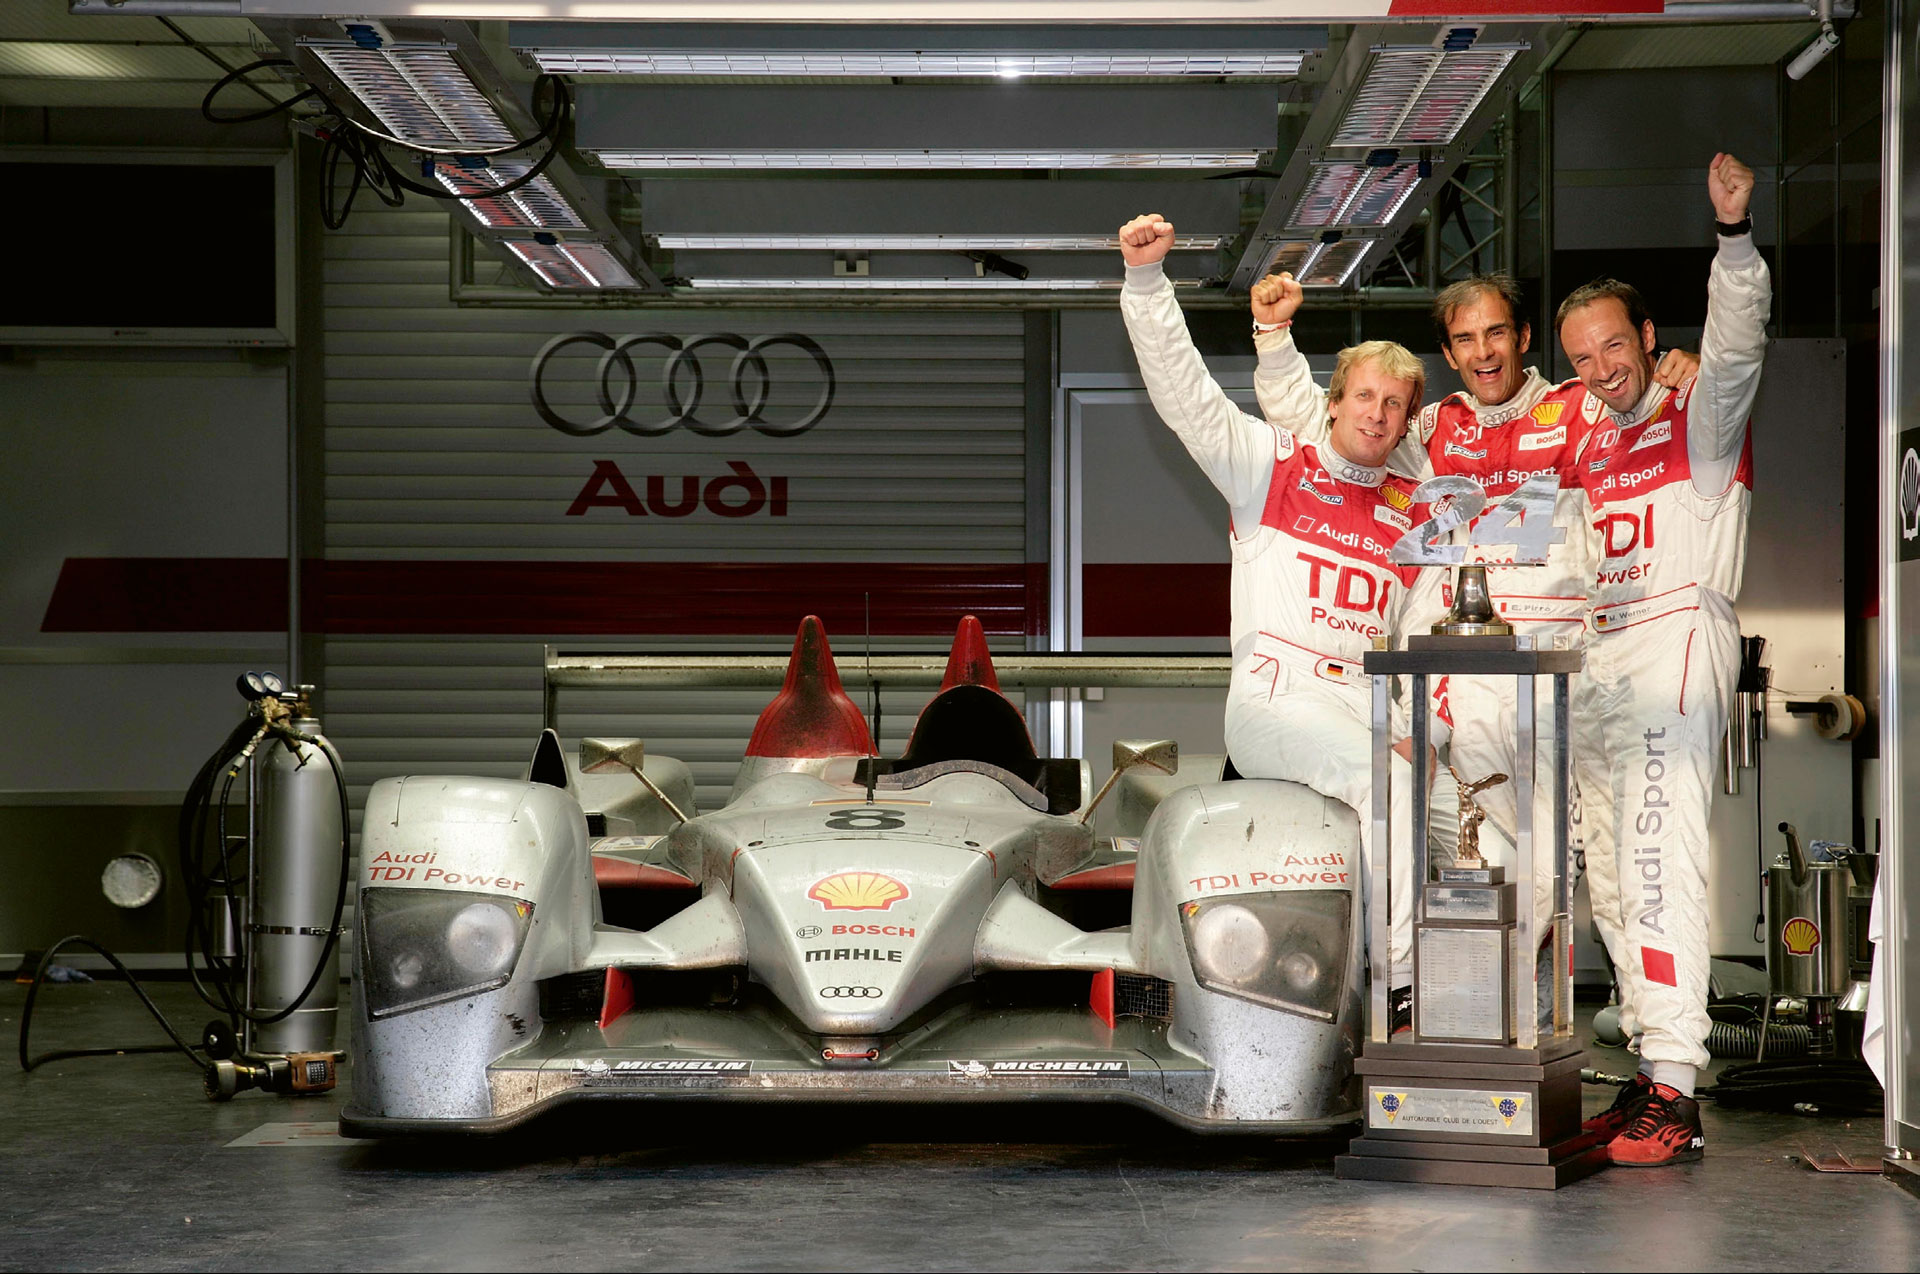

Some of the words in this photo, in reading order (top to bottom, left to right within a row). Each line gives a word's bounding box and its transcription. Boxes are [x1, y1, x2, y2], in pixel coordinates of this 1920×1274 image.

[1536, 430, 1564, 444] BOSCH
[1594, 429, 1621, 450] TDI
[1641, 426, 1670, 442] BOSCH
[1619, 461, 1665, 487] Sport
[565, 460, 788, 518] Audi
[1390, 514, 1411, 530] BOSC
[1316, 522, 1359, 547] Audi
[1296, 551, 1393, 621] TDI
[1636, 727, 1670, 836] Sport
[825, 808, 906, 831] 8
[373, 851, 438, 865] Audi
[1284, 853, 1345, 867] Audi
[368, 866, 416, 882] TDI
[423, 868, 526, 892] Power
[1189, 874, 1240, 893] TDI
[1250, 872, 1349, 887] Power
[1635, 847, 1664, 935] Audi
[831, 924, 915, 938] BOSCH
[805, 948, 902, 963] MAHLE
[614, 1060, 747, 1071] MICHELIN
[992, 1061, 1123, 1072] MICHELIN
[1402, 1115, 1441, 1123] AUTOMOBILE
[1443, 1116, 1460, 1124] CLUB
[1462, 1117, 1470, 1125] DE
